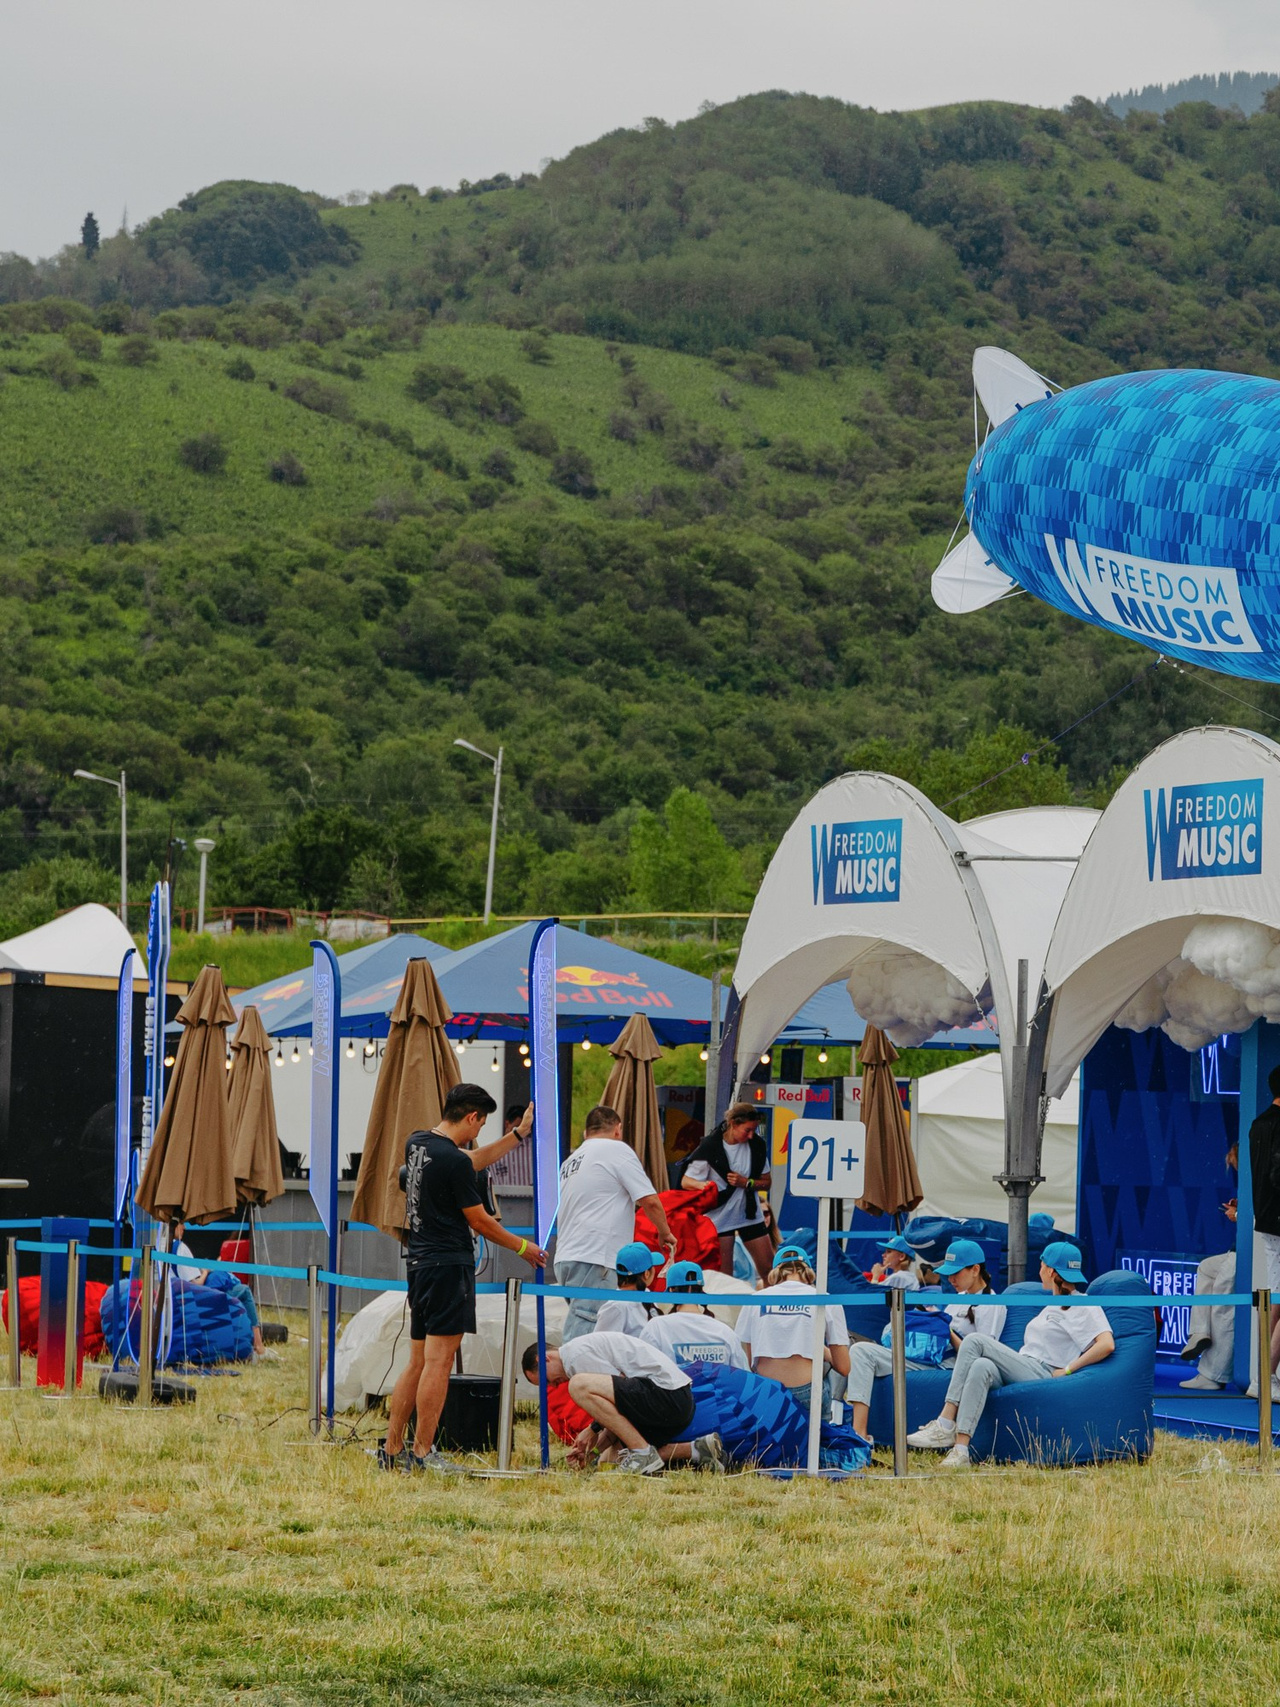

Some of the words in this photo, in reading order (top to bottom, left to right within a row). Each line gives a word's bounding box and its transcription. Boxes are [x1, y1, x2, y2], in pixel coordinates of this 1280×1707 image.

[1095, 556, 1228, 605] FREEDOM
[1111, 592, 1244, 645] MUSIC
[1176, 792, 1256, 824] FREEDOM
[835, 831, 897, 856] FREEDOM
[1177, 823, 1256, 868] MUSIC
[835, 857, 896, 894] MUSIC
[597, 988, 674, 1009] Bull
[669, 1089, 693, 1102] Red
[778, 1088, 803, 1101] Red
[805, 1089, 830, 1102] Bull
[797, 1135, 859, 1182] 21+
[1153, 1270, 1198, 1296] FREE
[778, 1304, 811, 1313] MUSIC
[693, 1353, 725, 1361] MUSIC
